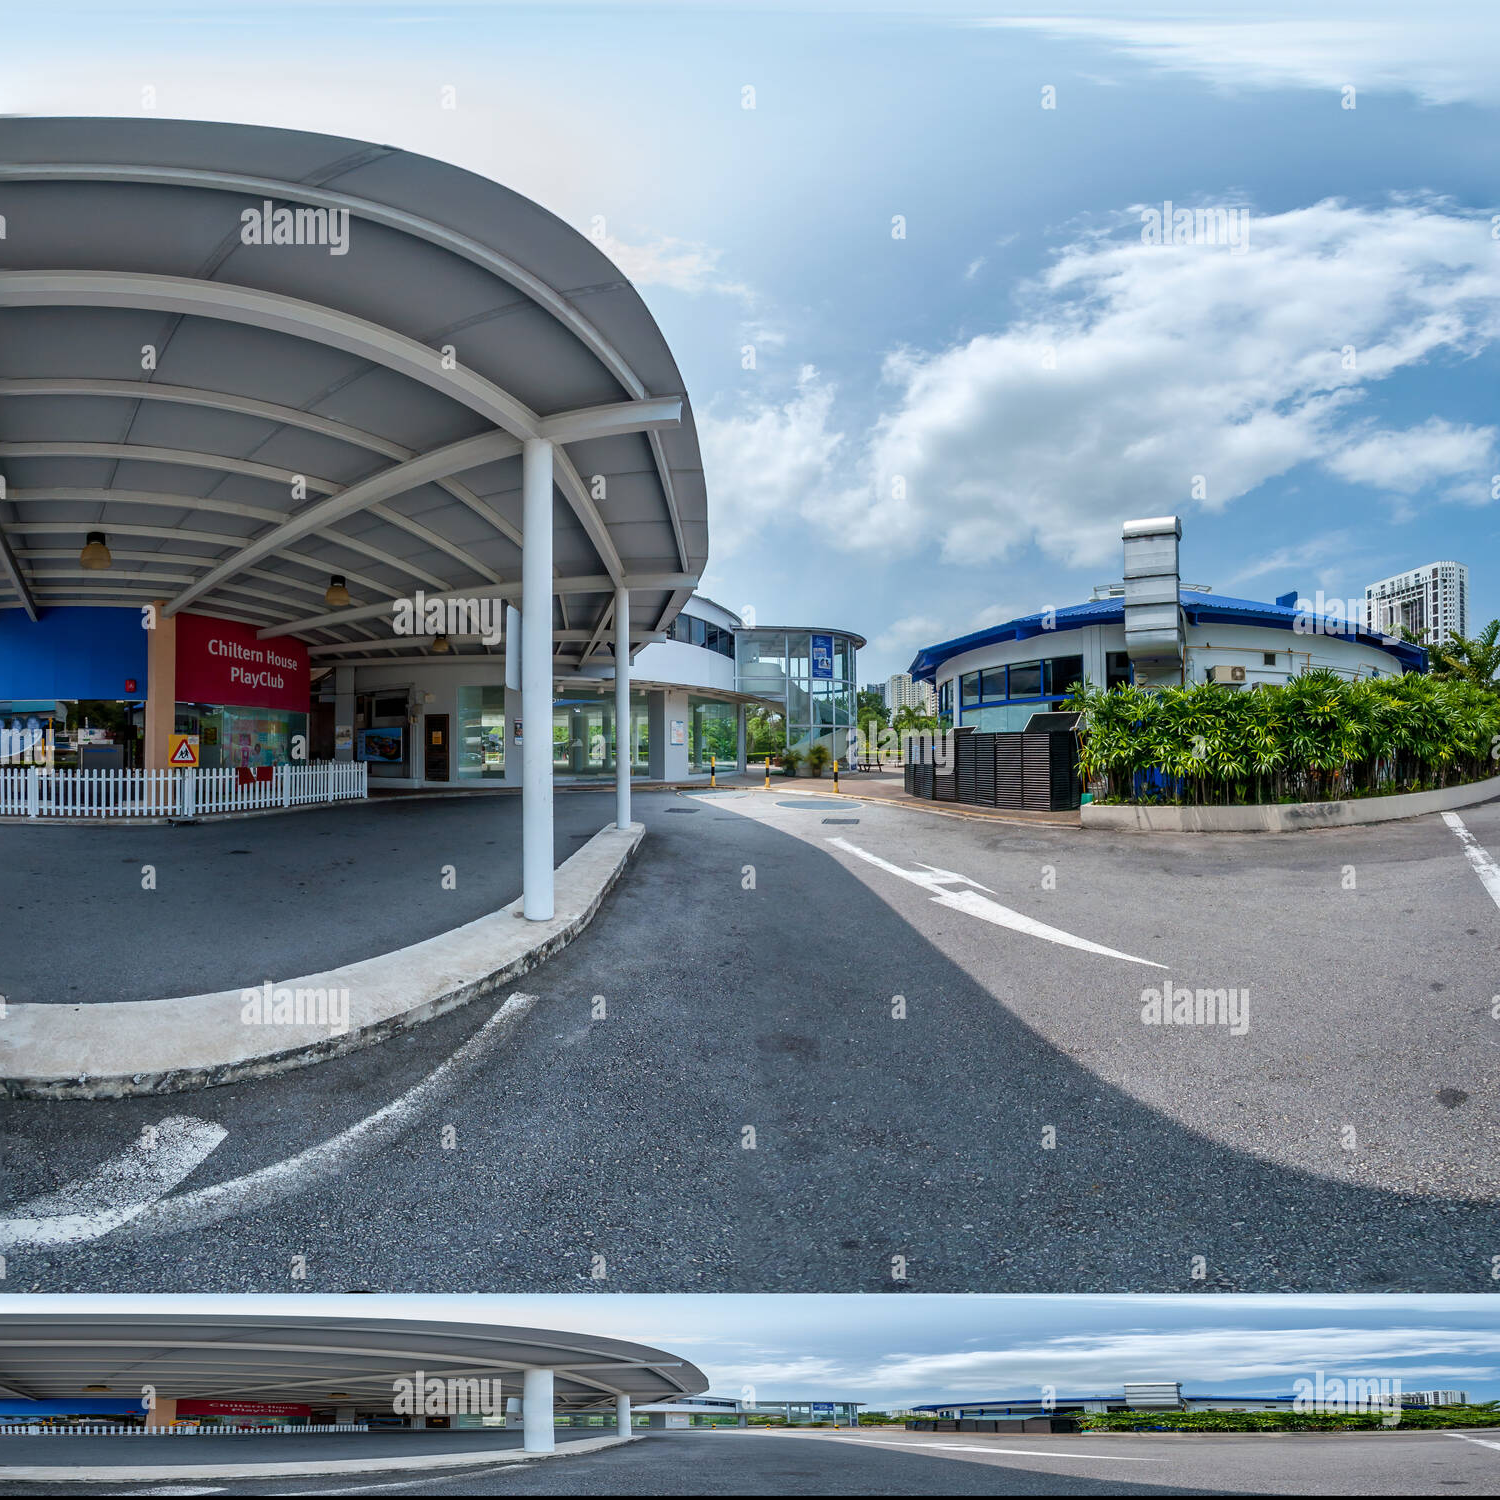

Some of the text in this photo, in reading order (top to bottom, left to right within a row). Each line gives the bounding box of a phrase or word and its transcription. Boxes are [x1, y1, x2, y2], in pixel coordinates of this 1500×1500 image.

[208, 639, 297, 670] Chiltern House
[230, 667, 284, 688] PlayClub
